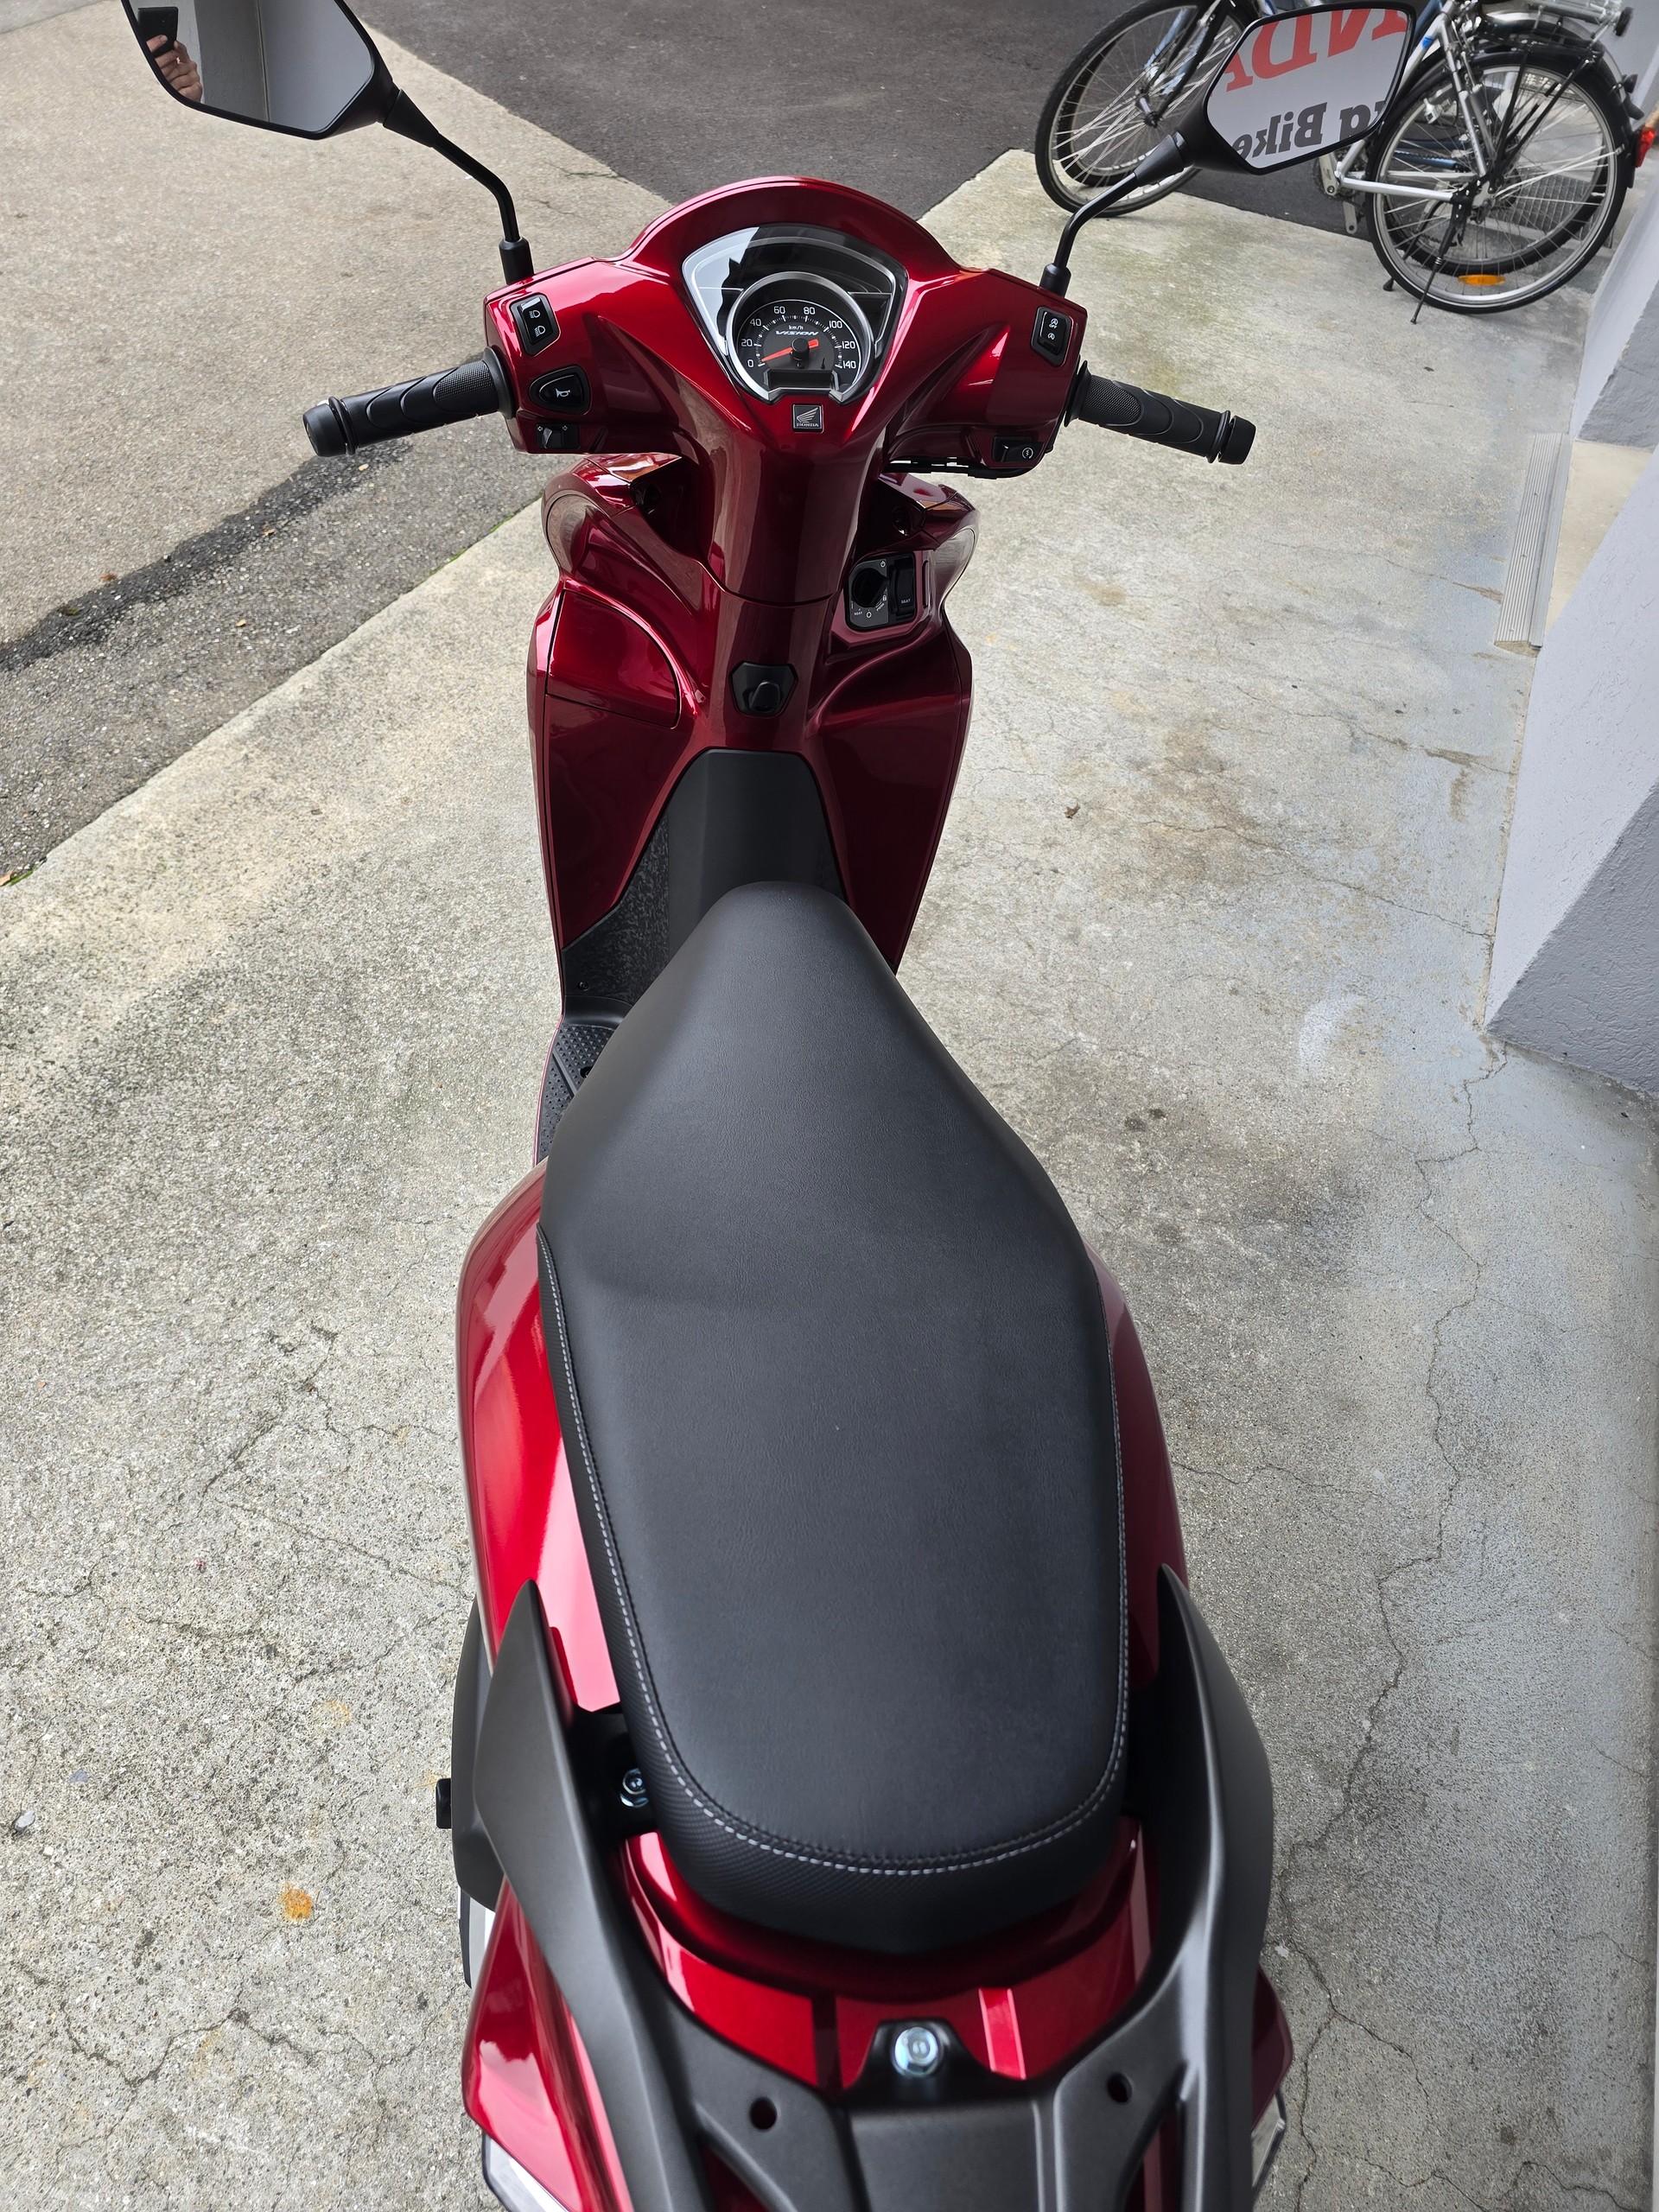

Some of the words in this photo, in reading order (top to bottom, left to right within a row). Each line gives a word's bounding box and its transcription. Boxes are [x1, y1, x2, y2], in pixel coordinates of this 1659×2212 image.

[774, 306, 785, 315] 60
[804, 306, 816, 315] 80
[750, 318, 762, 327] 40
[829, 320, 842, 329] 100
[741, 339, 753, 347] 20
[842, 340, 855, 349] 120
[747, 359, 754, 368] 0
[842, 360, 856, 369] 140
